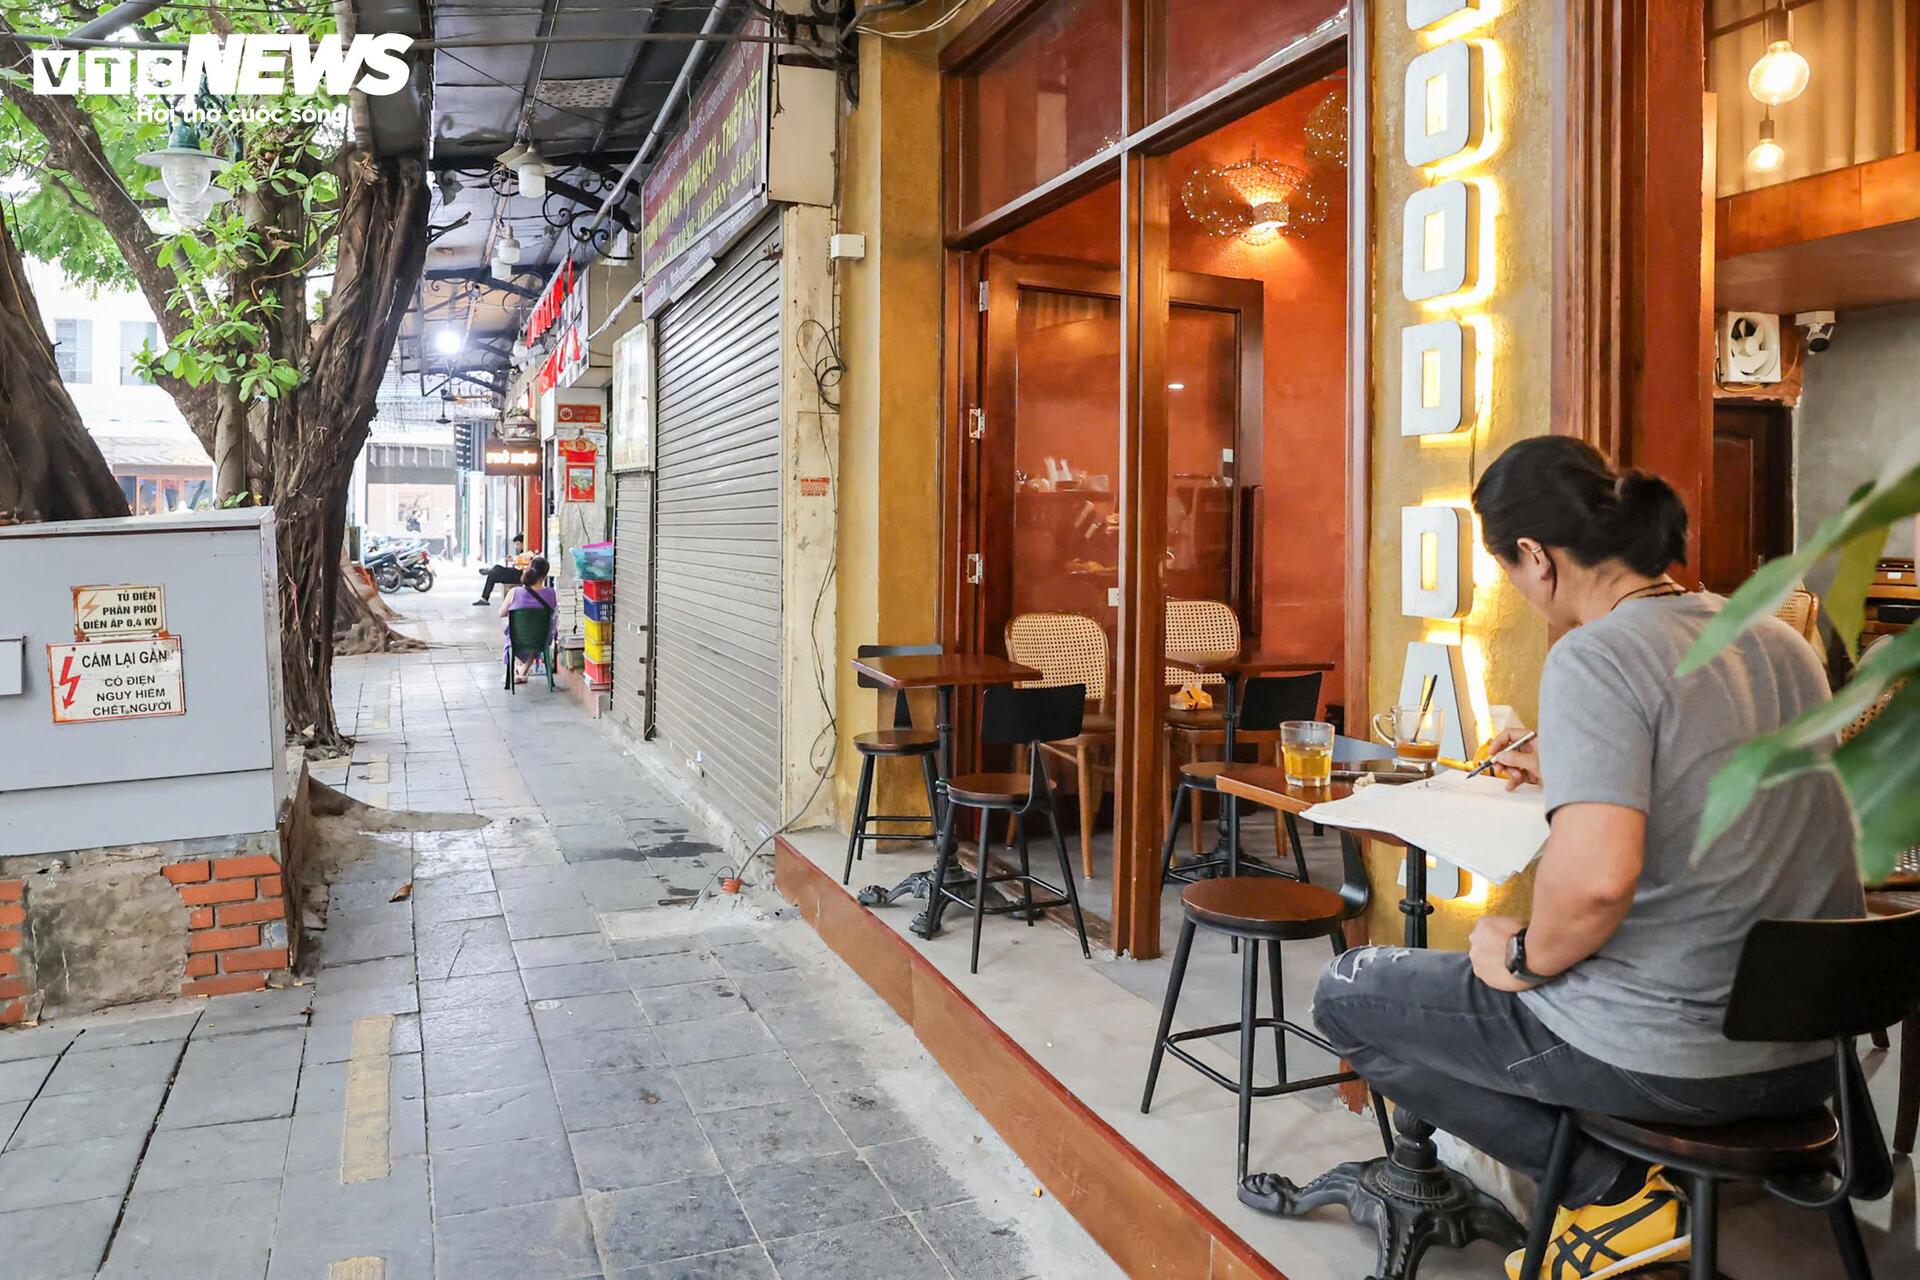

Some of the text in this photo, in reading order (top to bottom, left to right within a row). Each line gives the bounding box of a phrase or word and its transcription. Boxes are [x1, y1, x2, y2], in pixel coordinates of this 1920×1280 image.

[1402, 0, 1478, 436] OOD
[117, 590, 156, 602] TỦ ĐIỆN
[103, 602, 157, 615] PHÂN PHỐI
[83, 619, 107, 630] ĐIỆN
[110, 617, 124, 628] ÁP
[144, 617, 158, 627] KV
[115, 652, 136, 668] LẠI
[104, 674, 156, 688] CÓ ĐIỆN
[96, 690, 132, 702] NGUY
[92, 698, 172, 716] CHẾT NGƯỜI
